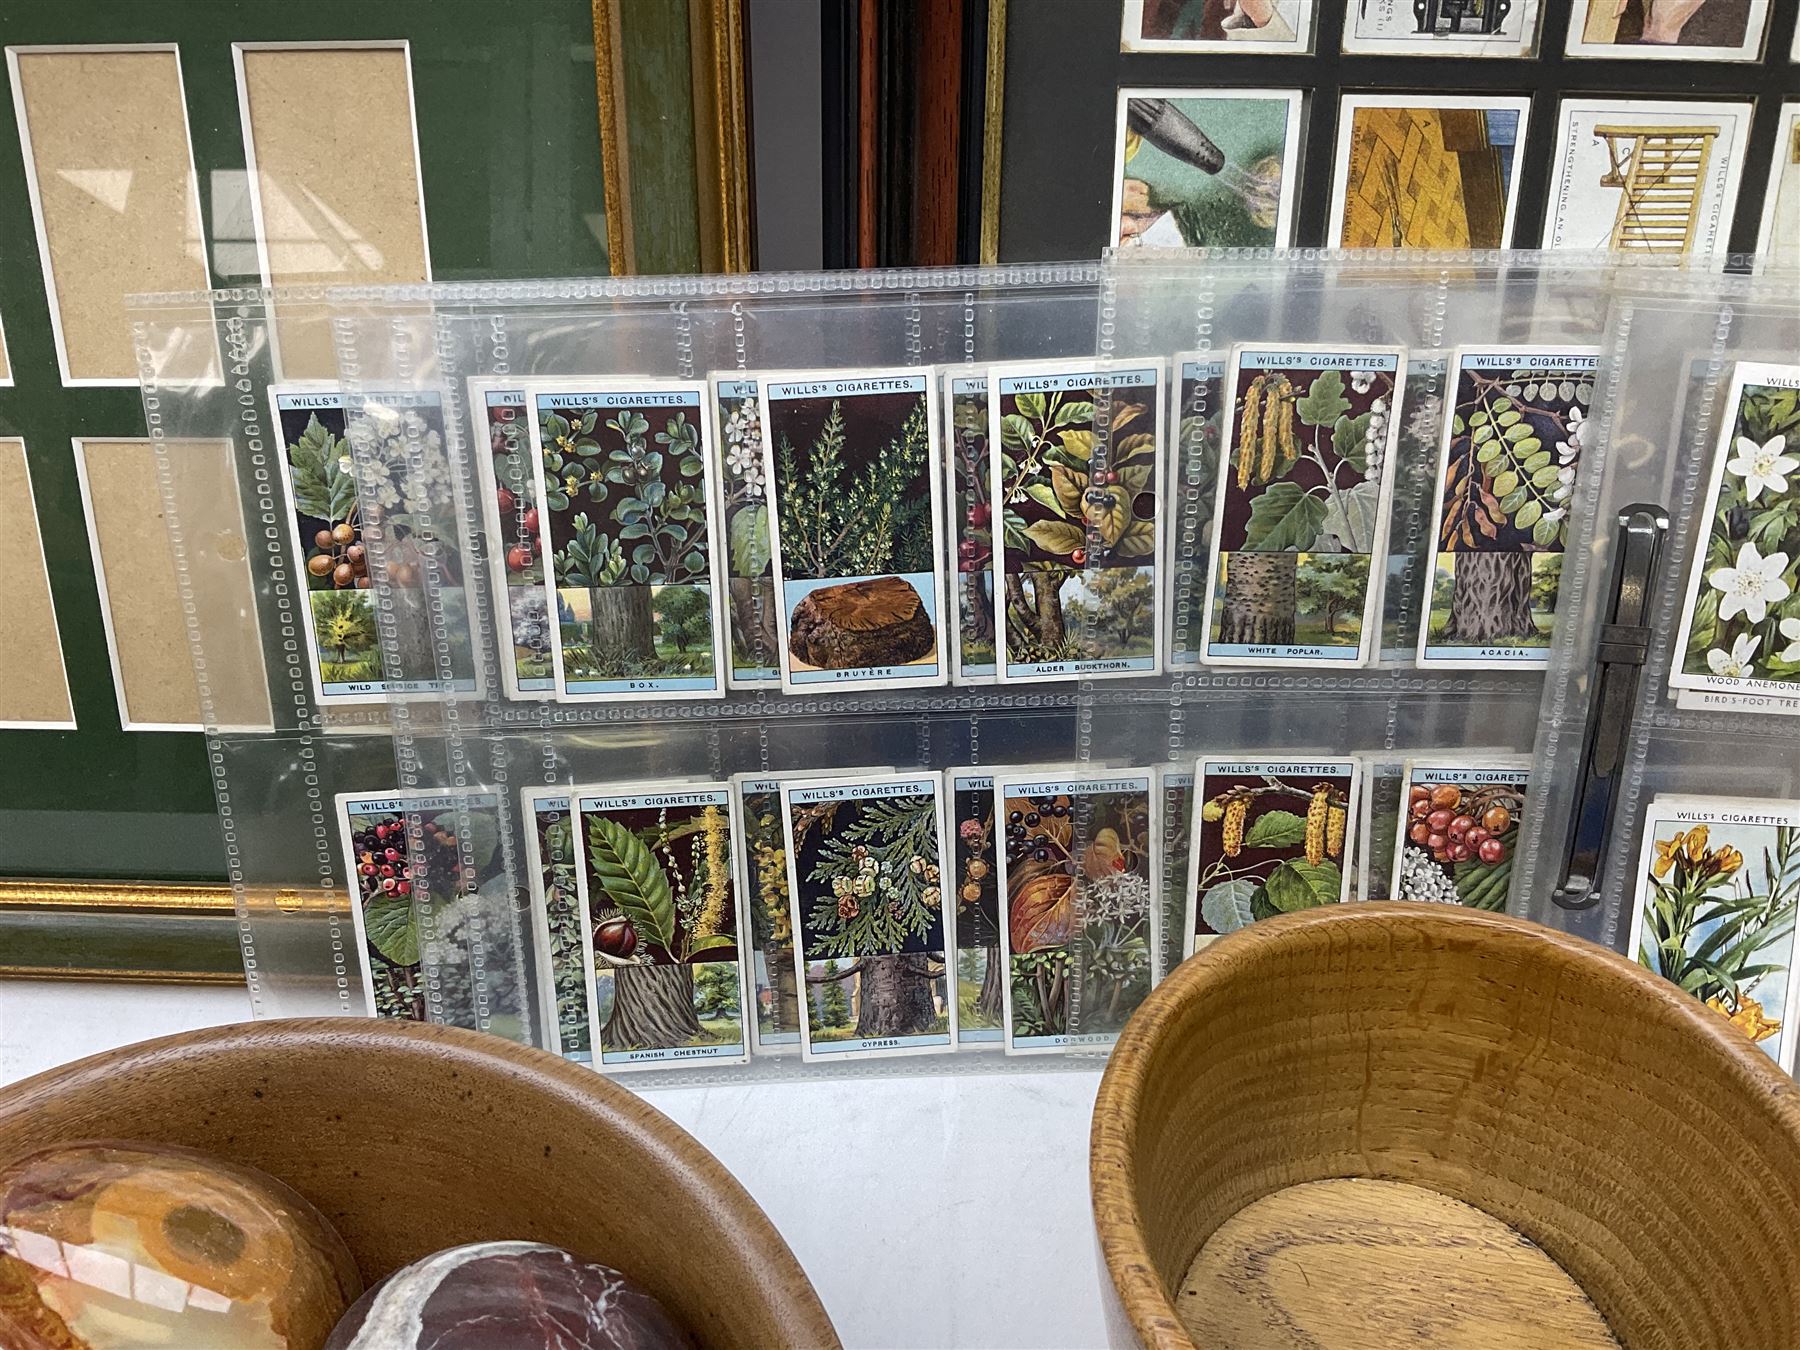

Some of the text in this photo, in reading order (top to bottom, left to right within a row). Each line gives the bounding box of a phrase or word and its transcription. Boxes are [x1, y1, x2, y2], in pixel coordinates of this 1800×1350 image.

[1560, 121, 1579, 211] STRENGTHENING
[1557, 216, 1568, 231] AN
[1309, 357, 1388, 368] CIGARETTES.
[835, 380, 914, 393] CIGARETTES.
[606, 395, 687, 405] CIGARETTES.
[1287, 648, 1324, 656] POPLAR.
[1036, 665, 1064, 673] ALDER
[1706, 676, 1740, 686] WOOD
[1779, 699, 1799, 708] TRE
[1267, 765, 1340, 774] CIGARETTES.
[1474, 773, 1529, 782] CIGARETT
[852, 784, 922, 797] CIGARETTES.
[644, 794, 717, 805] CIGARETTES.
[1721, 814, 1789, 825] CIGARETTES
[630, 1048, 718, 1059] SPANISH CHESTNUT
